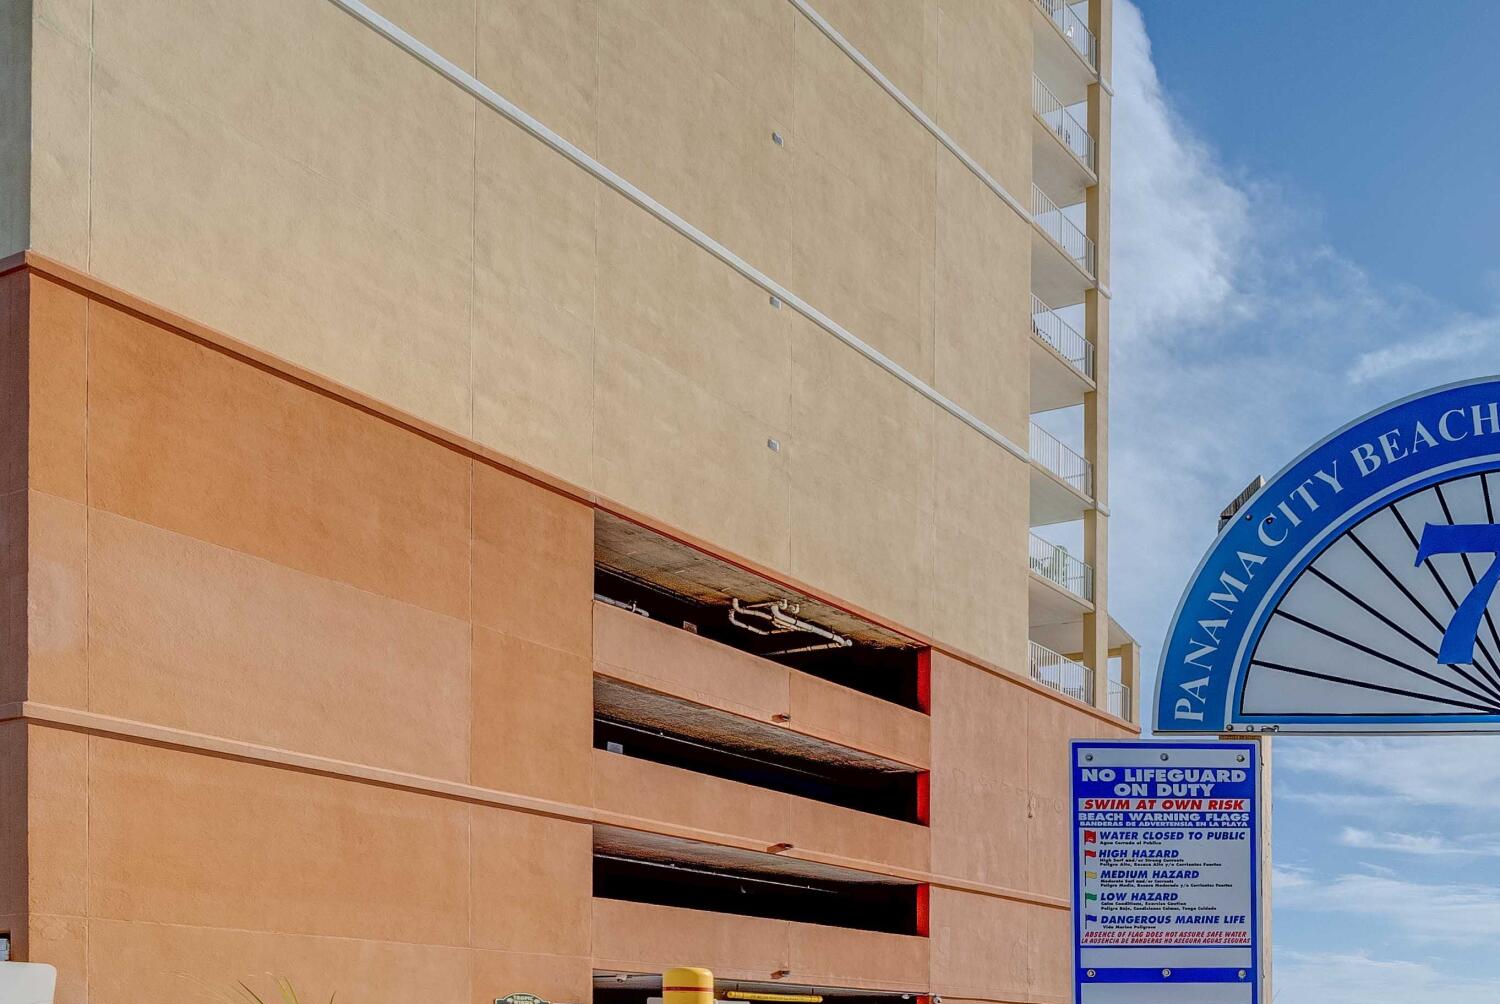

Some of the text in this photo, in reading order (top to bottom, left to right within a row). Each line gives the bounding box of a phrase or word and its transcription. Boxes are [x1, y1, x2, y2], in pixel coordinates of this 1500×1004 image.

[1174, 550, 1268, 722] PANAMA
[1257, 460, 1344, 547] CITY
[1350, 402, 1500, 478] BEACH
[1081, 769, 1247, 783] NO LIFEGUARD
[1113, 784, 1216, 797] ON DUTY
[1084, 800, 1245, 810] SWIM AT OWN RISK
[1078, 813, 1250, 821] BEACH WARNING FLAGS
[1099, 832, 1246, 840] WATER CLOSED TO PUBLIC
[1098, 850, 1179, 858] HIGH HAZARD
[1100, 893, 1179, 901] LOW HAZARD
[1100, 916, 1246, 924] DANGEROUS MARINE LIFE
